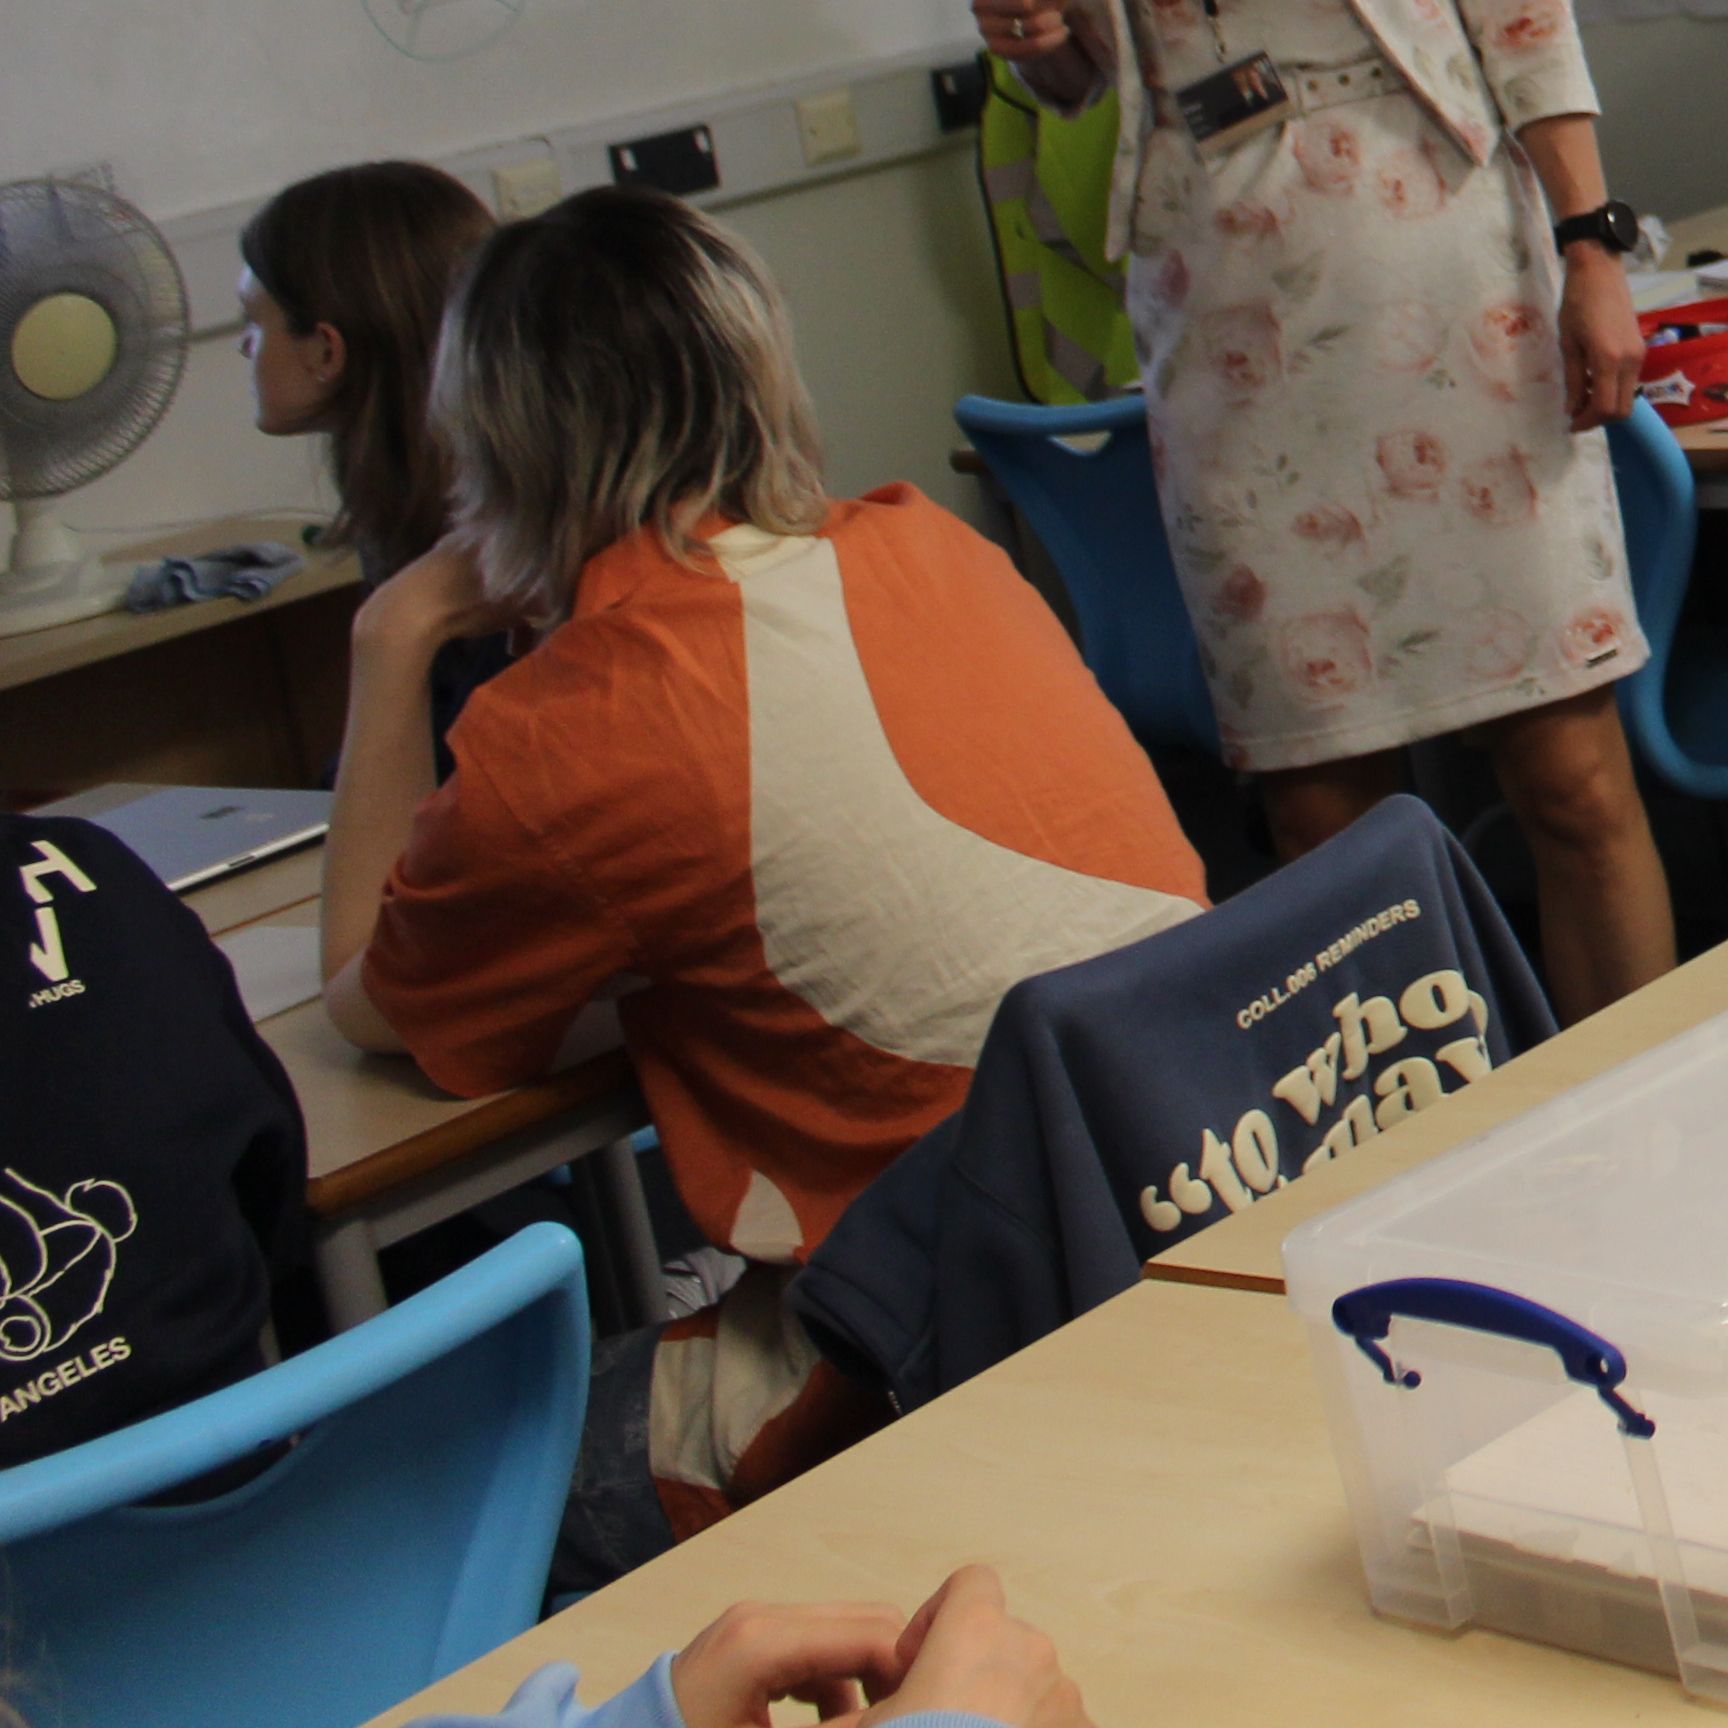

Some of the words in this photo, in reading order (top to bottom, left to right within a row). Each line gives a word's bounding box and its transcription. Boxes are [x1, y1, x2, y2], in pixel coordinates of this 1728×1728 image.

[1315, 898, 1421, 972] REMINDERS
[1272, 969, 1489, 1126] who
[0, 1335, 132, 1423] ANGELES
